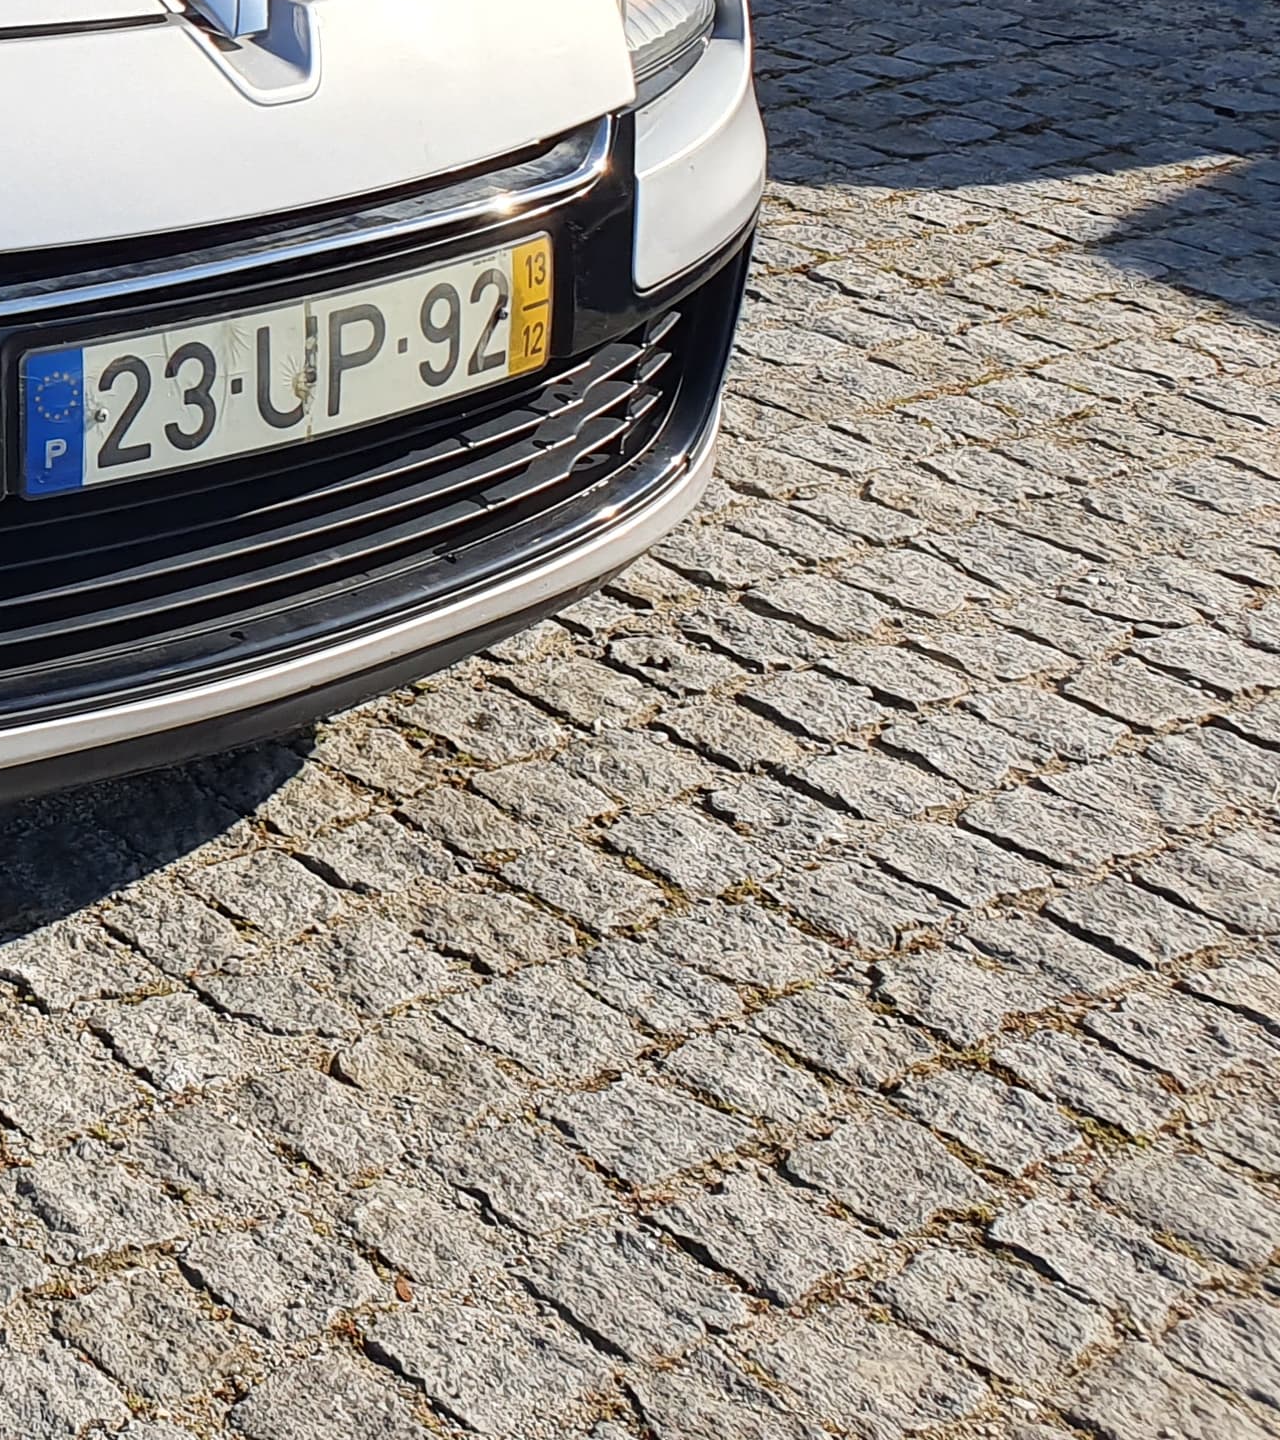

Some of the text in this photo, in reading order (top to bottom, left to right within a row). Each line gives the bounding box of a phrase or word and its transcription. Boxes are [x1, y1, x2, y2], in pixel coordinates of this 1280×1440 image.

[525, 254, 546, 289] 13
[522, 321, 544, 357] 12
[45, 438, 67, 469] P
